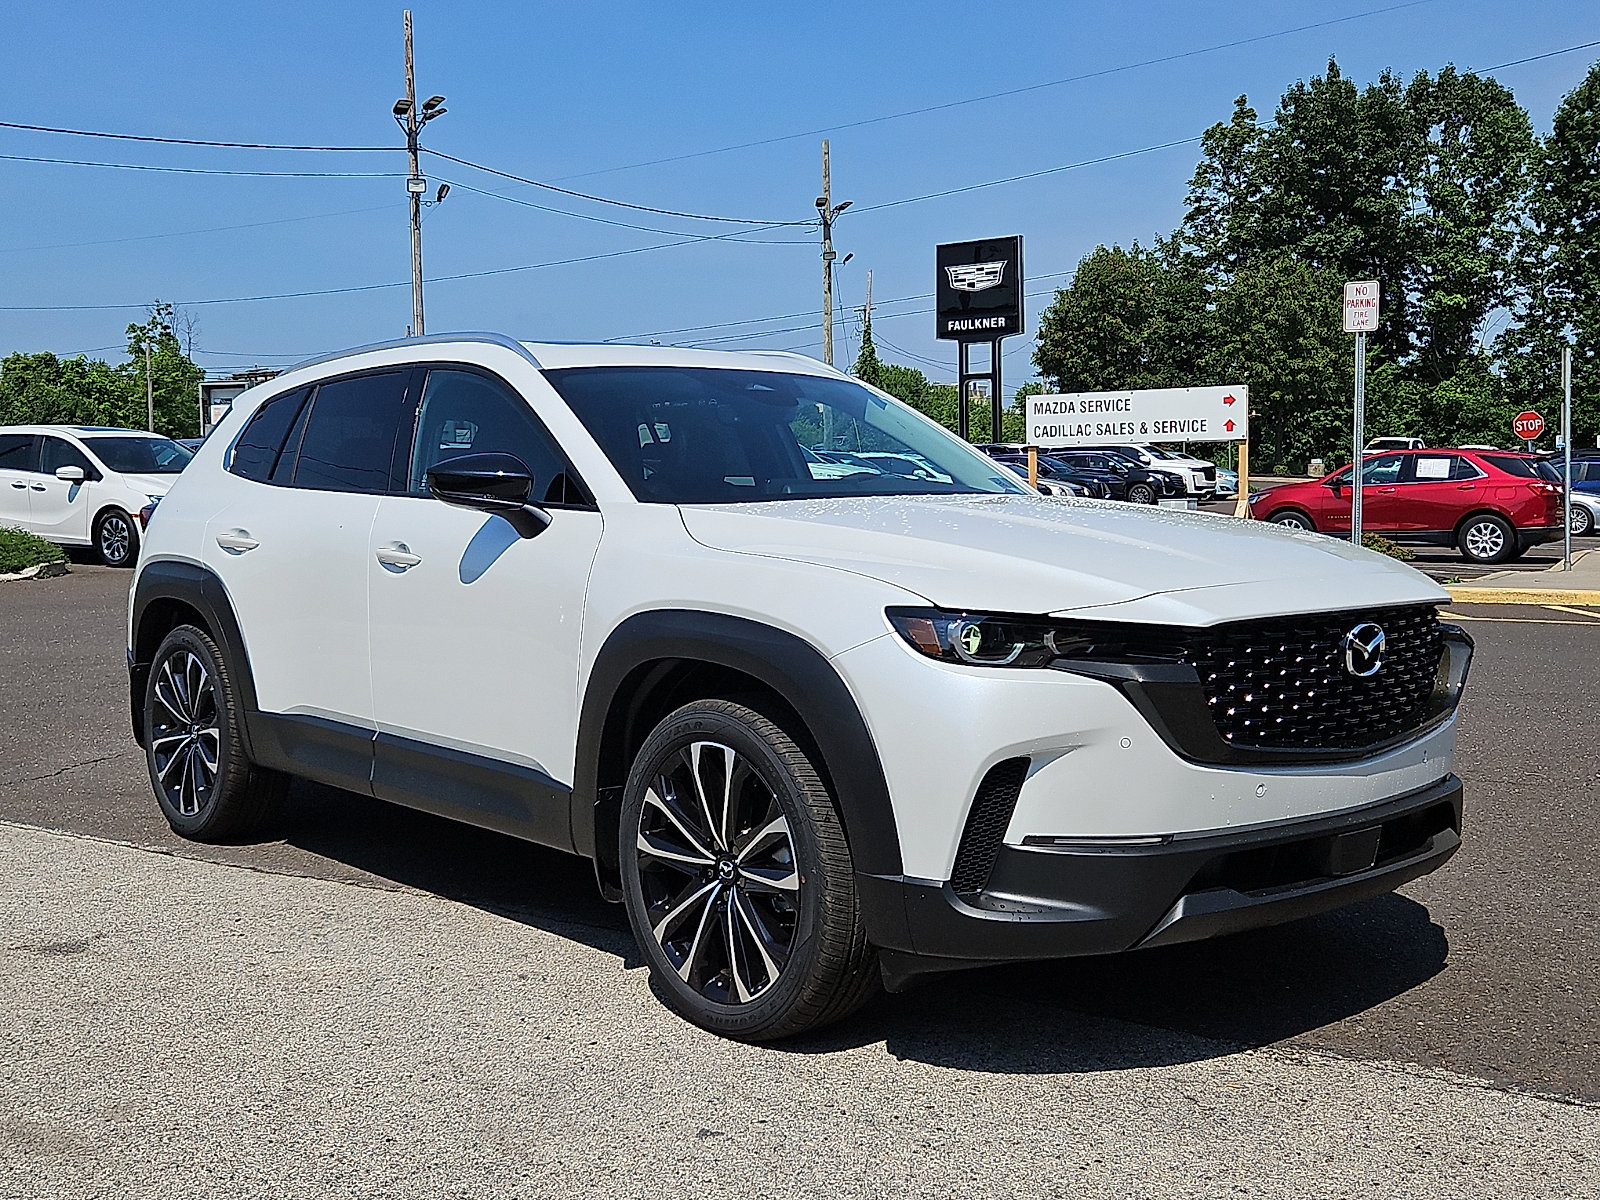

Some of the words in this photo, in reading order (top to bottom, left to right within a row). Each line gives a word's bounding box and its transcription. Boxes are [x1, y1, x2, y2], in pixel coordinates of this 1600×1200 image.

[1355, 286, 1368, 297] NO
[1346, 298, 1376, 309] PARKING
[947, 317, 1006, 331] FAULKNER
[1033, 401, 1076, 415] MAZDA
[1079, 398, 1131, 413] SERVICE
[1033, 423, 1092, 438] CADILLAC
[1095, 422, 1135, 436] SALES
[1139, 421, 1149, 435] &
[1153, 419, 1207, 434] SERVICE
[1515, 419, 1542, 432] STOP
